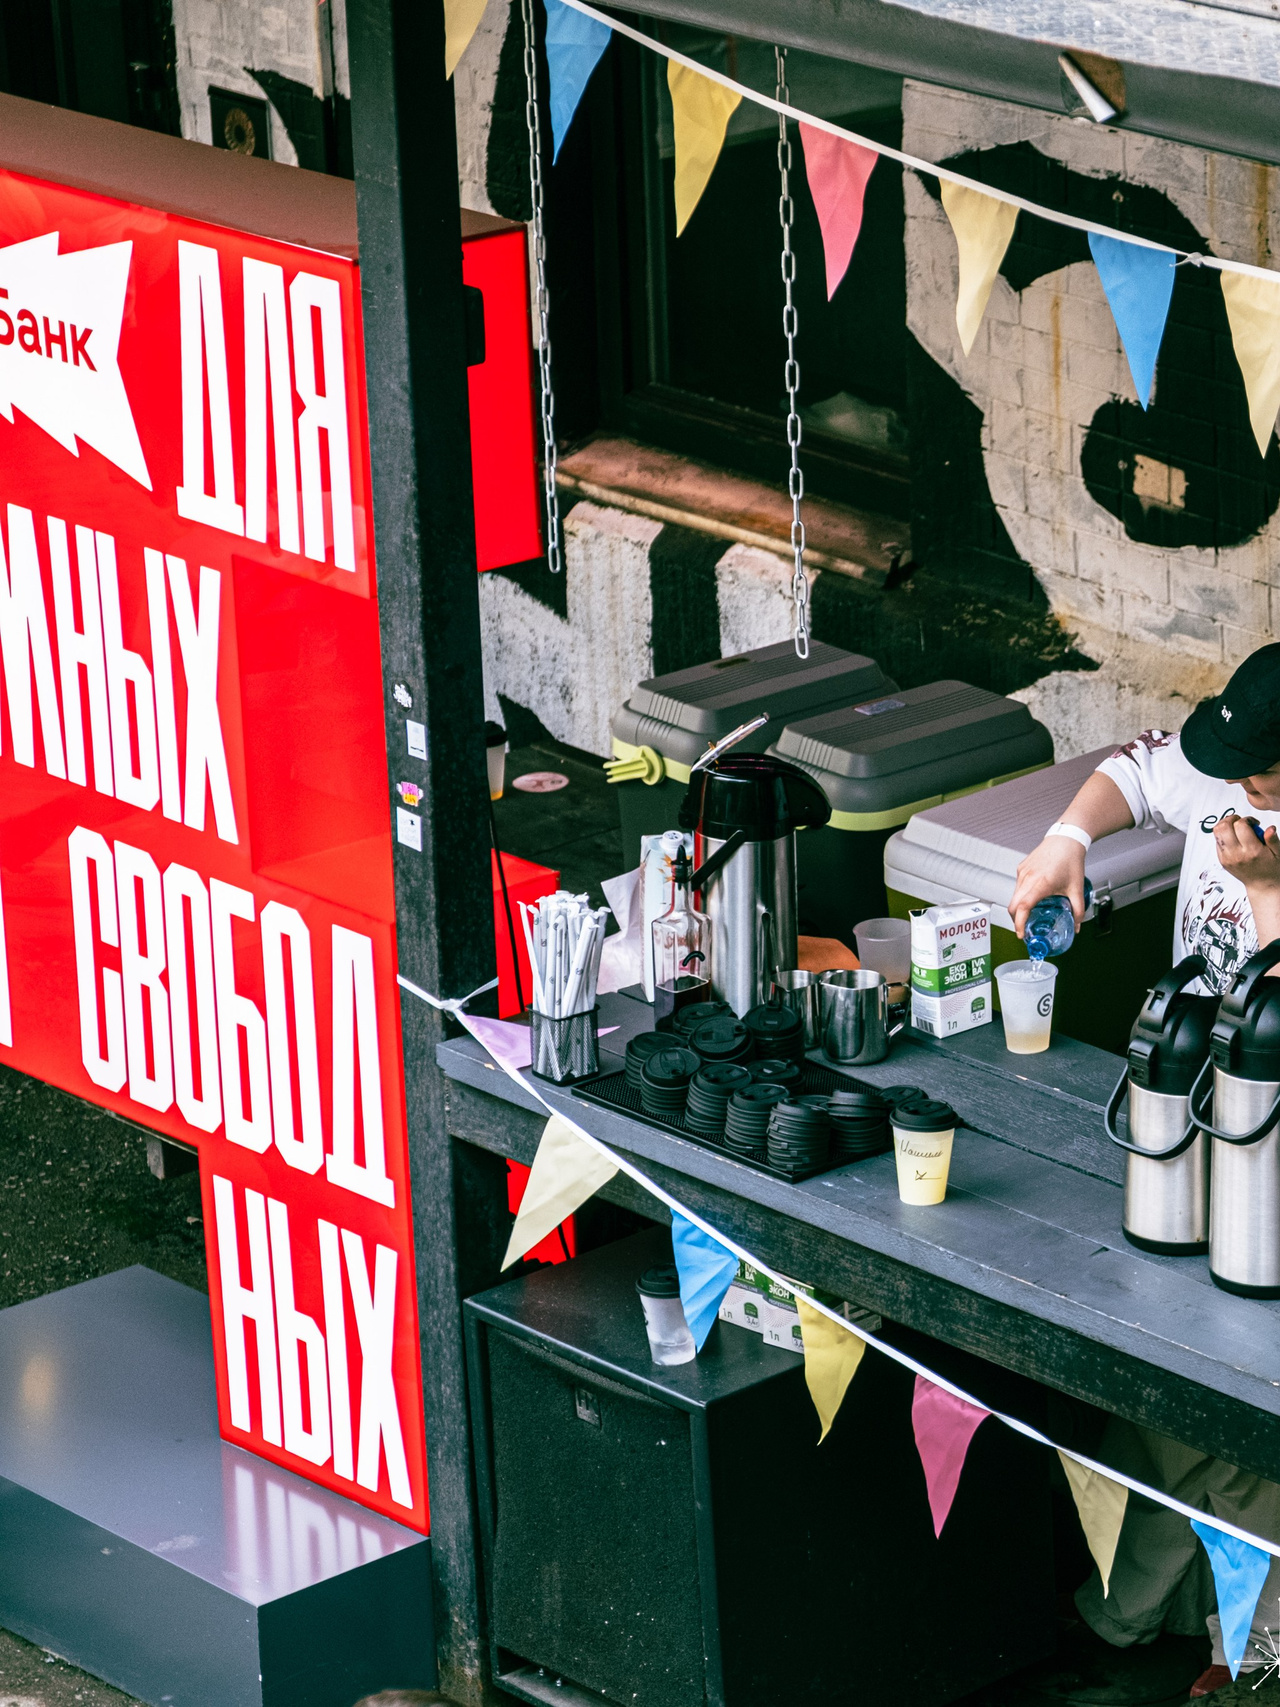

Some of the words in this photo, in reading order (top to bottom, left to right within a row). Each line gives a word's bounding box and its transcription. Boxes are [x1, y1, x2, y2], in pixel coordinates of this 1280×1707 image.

[176, 239, 356, 573] ДЛЯ
[67, 825, 396, 1209] СВОБОД
[939, 917, 987, 940] МОЛОКО
[970, 929, 987, 940] 3,2%
[212, 1174, 413, 1510] НЫХ
